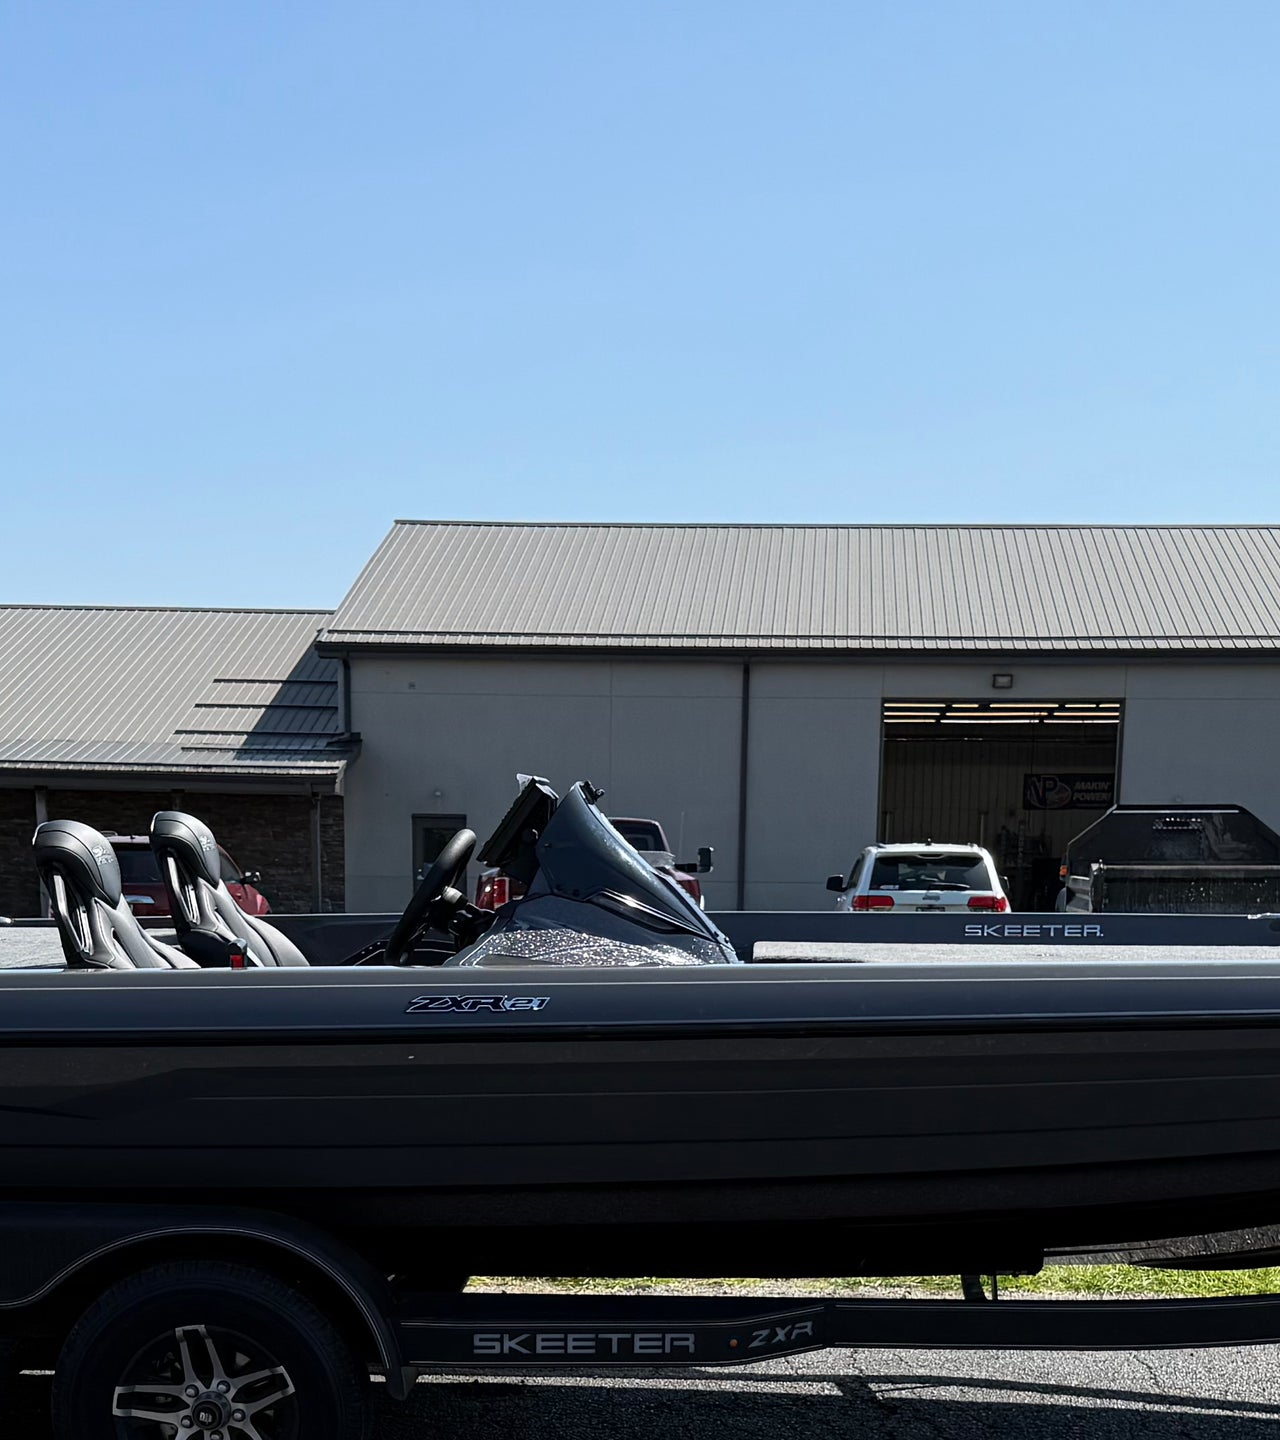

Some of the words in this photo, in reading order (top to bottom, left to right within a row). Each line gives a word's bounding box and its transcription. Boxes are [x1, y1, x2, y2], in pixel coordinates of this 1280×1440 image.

[964, 924, 1104, 938] SKEETER
[406, 995, 507, 1013] ZXR
[506, 997, 550, 1010] 21
[473, 1333, 695, 1354] SKEETER
[748, 1321, 813, 1348] ZXR
